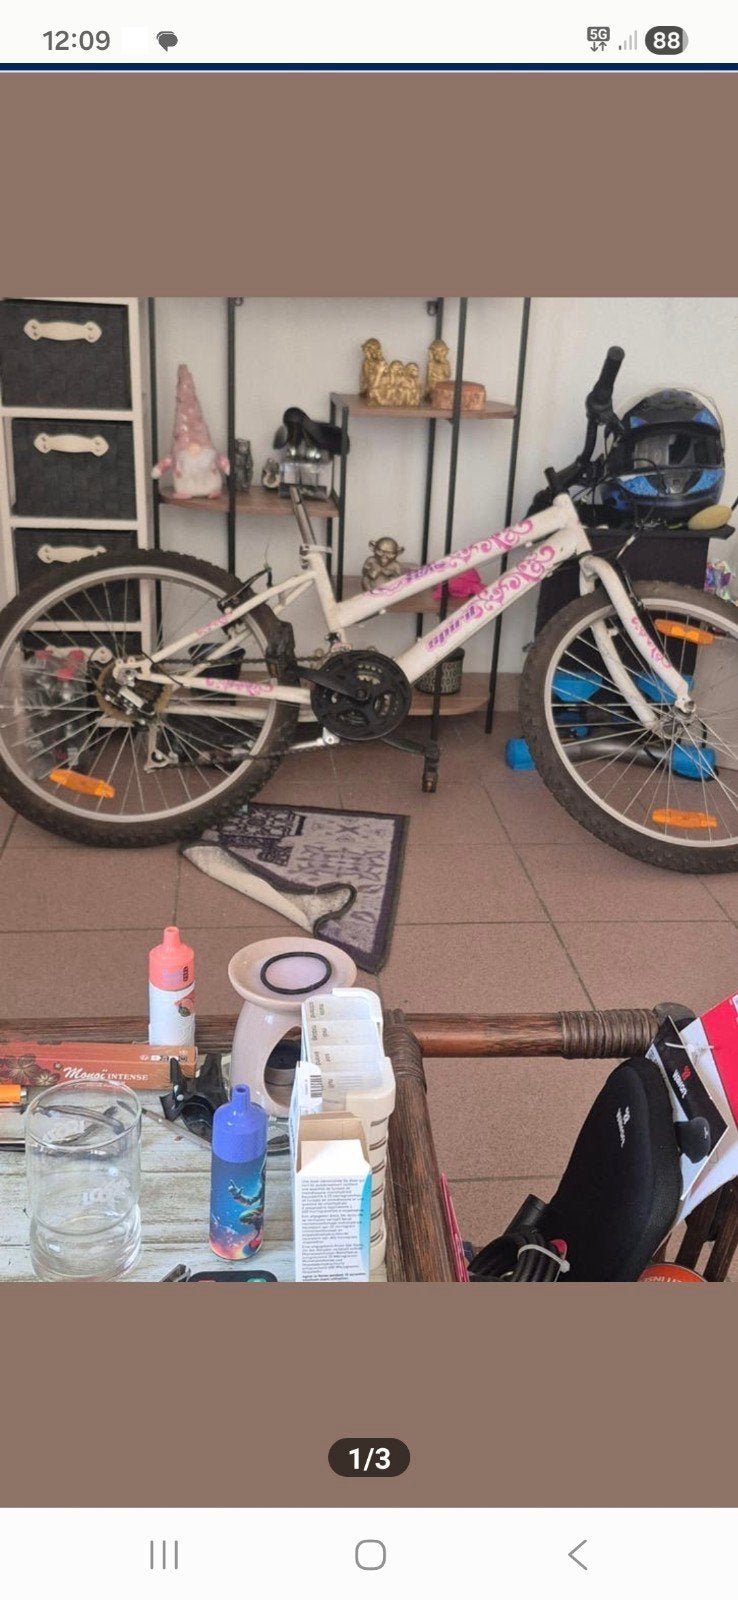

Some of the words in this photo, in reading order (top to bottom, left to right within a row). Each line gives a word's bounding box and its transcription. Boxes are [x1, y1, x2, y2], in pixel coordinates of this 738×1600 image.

[42, 30, 111, 51] 12:09
[589, 28, 609, 41] 5G
[653, 31, 681, 50] 88
[108, 1073, 148, 1082] INTENSE
